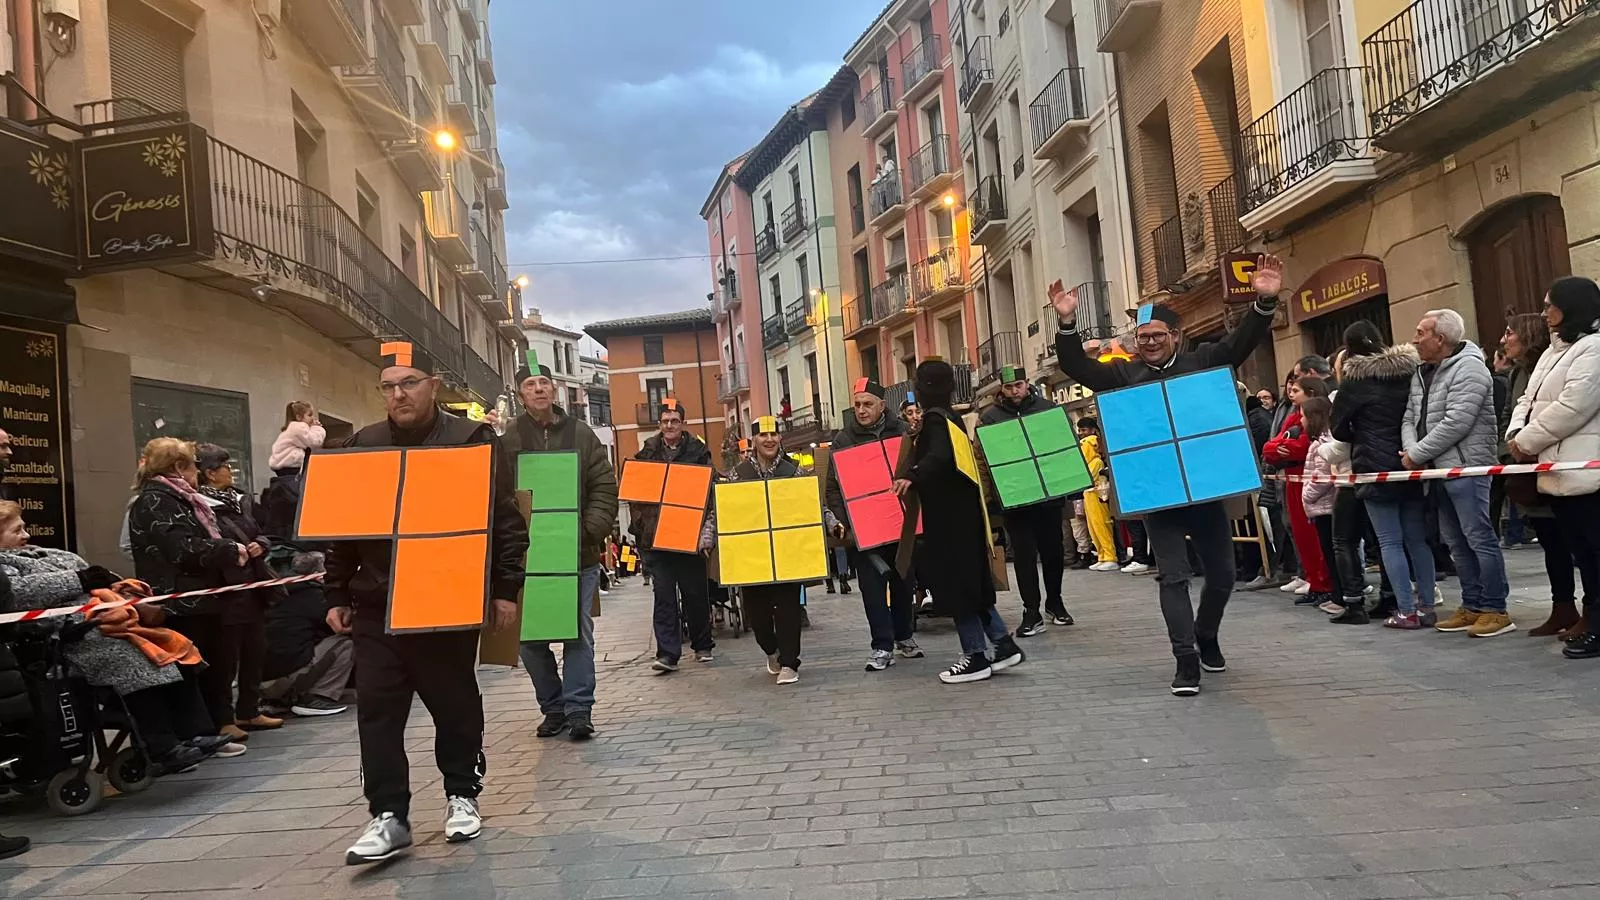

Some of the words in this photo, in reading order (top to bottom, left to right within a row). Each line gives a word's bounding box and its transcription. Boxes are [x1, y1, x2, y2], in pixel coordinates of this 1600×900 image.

[1230, 286, 1256, 294] TABAC
[1321, 273, 1368, 300] TABACOS
[0, 380, 50, 399] Maquillaje
[3, 407, 49, 422] Manicura
